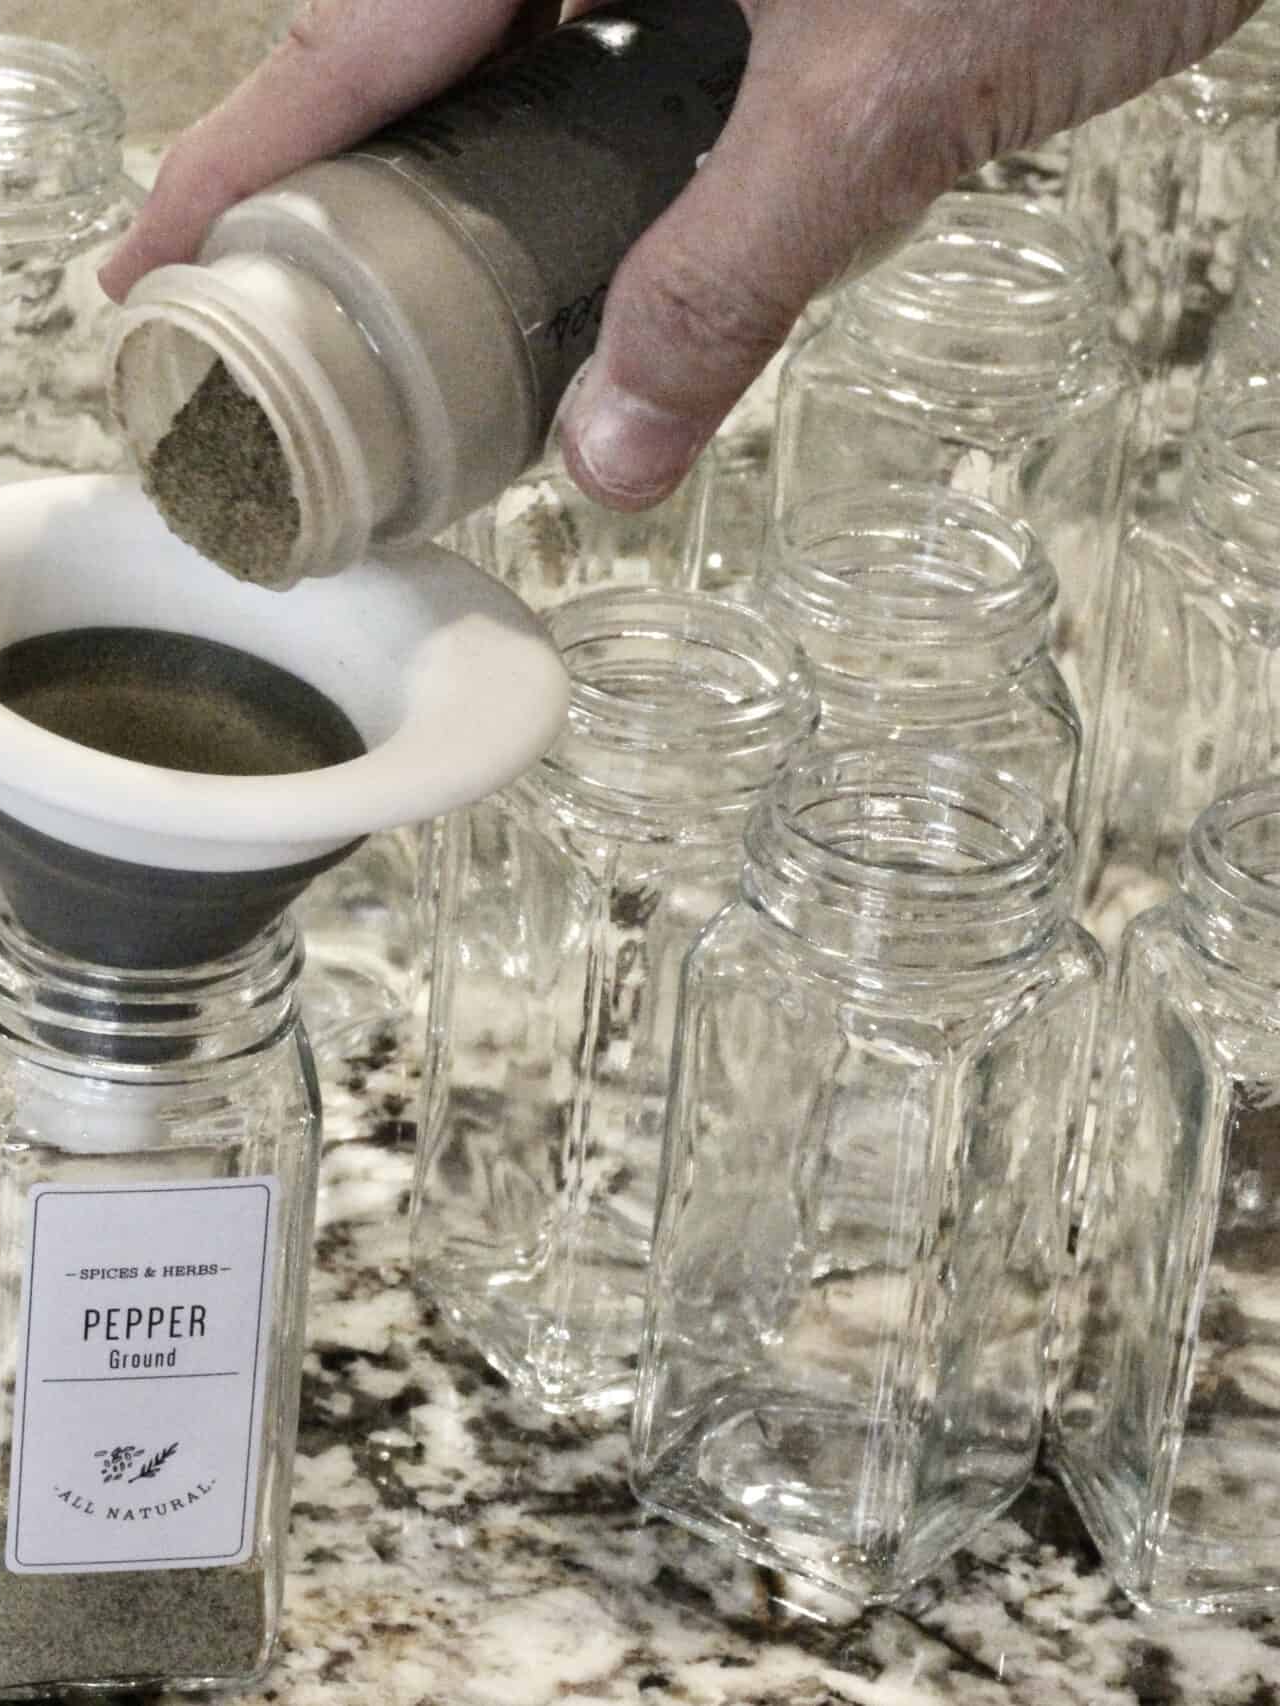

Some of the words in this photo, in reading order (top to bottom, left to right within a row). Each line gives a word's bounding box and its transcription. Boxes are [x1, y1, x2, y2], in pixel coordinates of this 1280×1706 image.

[79, 1266, 139, 1280] SPICES
[143, 1267, 157, 1278] &
[162, 1263, 219, 1278] HERBS
[83, 1304, 207, 1341] PEPPER
[109, 1347, 177, 1370] Ground
[57, 1488, 96, 1515] ALL
[106, 1482, 212, 1521] NATURAL
